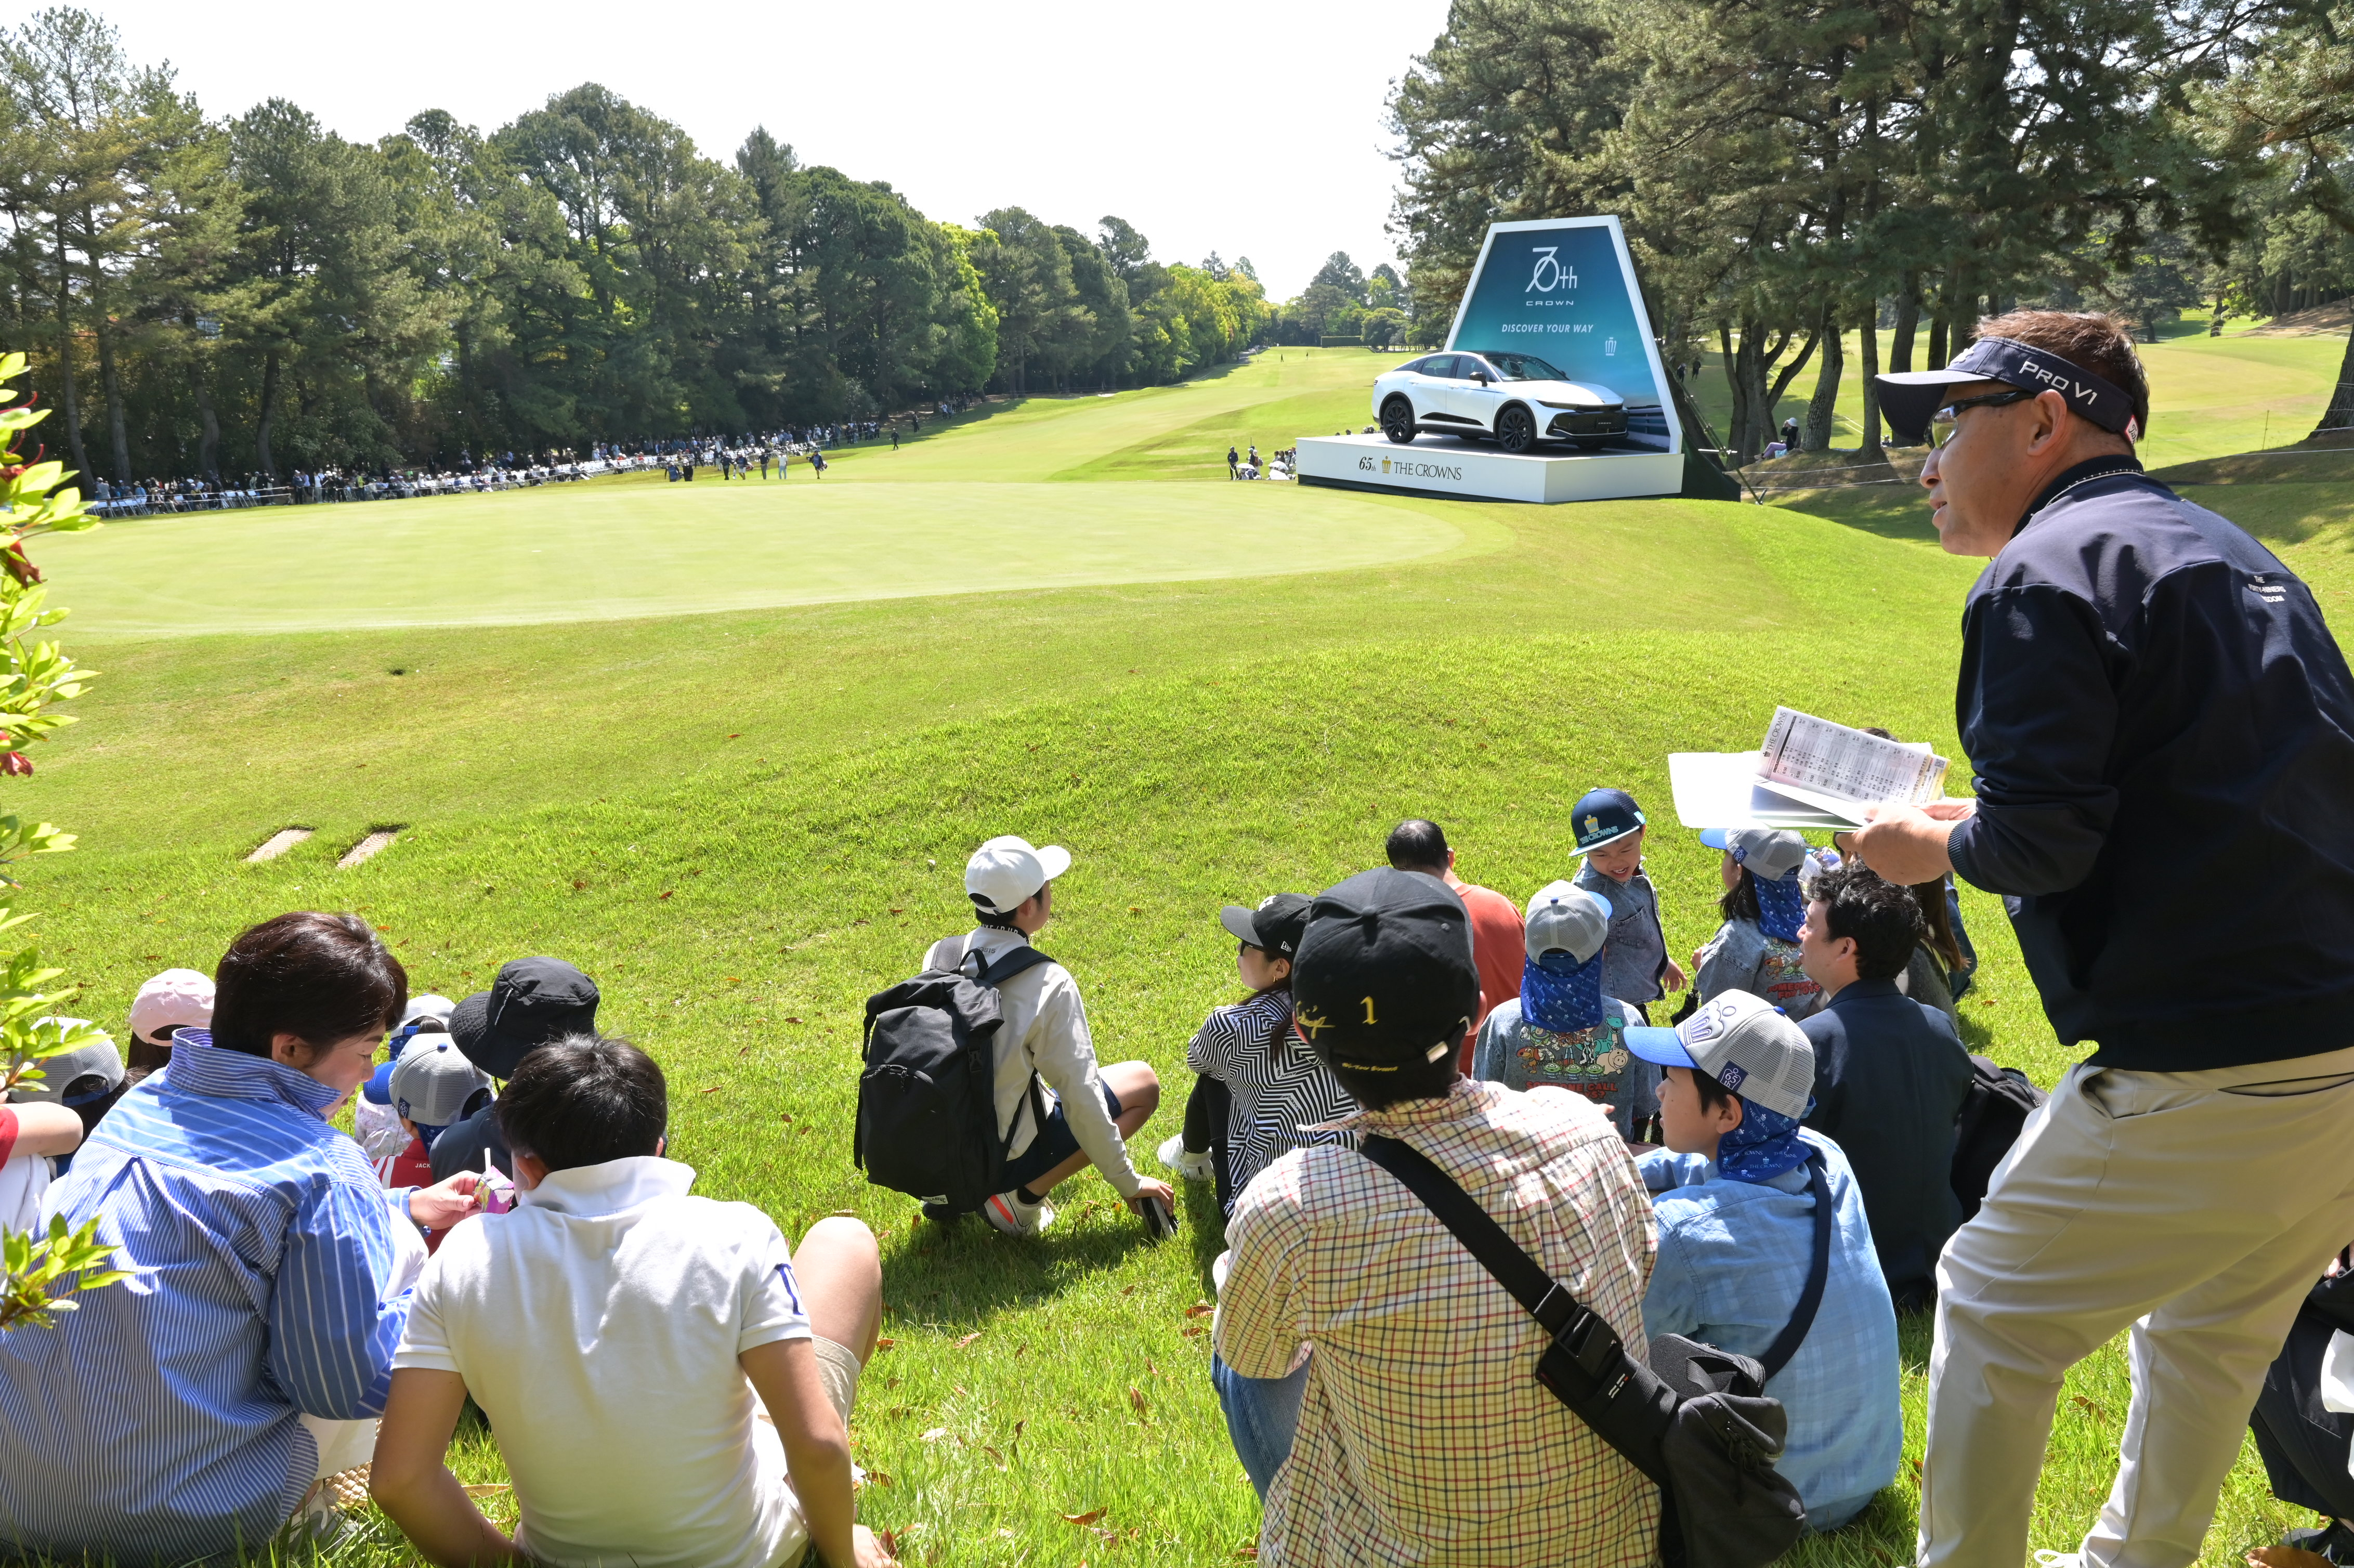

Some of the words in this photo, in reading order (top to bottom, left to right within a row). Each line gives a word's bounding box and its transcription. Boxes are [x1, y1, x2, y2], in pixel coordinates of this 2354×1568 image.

[1501, 324, 1544, 333] DISCOVER
[1547, 324, 1570, 333] YOUR
[1573, 324, 1594, 333] WAY
[2019, 361, 2070, 390] PRO
[2075, 382, 2098, 405] V1
[1394, 462, 1414, 475] THE
[1415, 463, 1461, 480] CROWNS
[1766, 737, 1776, 751] THE
[1772, 711, 1787, 738] CROWNS
[1588, 826, 1618, 841] CROWNS
[1360, 995, 1379, 1025] 1
[1725, 1073, 1738, 1083] 65
[1587, 1083, 1618, 1092] CALL
[1749, 1107, 1757, 1119] THE
[1755, 1117, 1770, 1133] CROWNS
